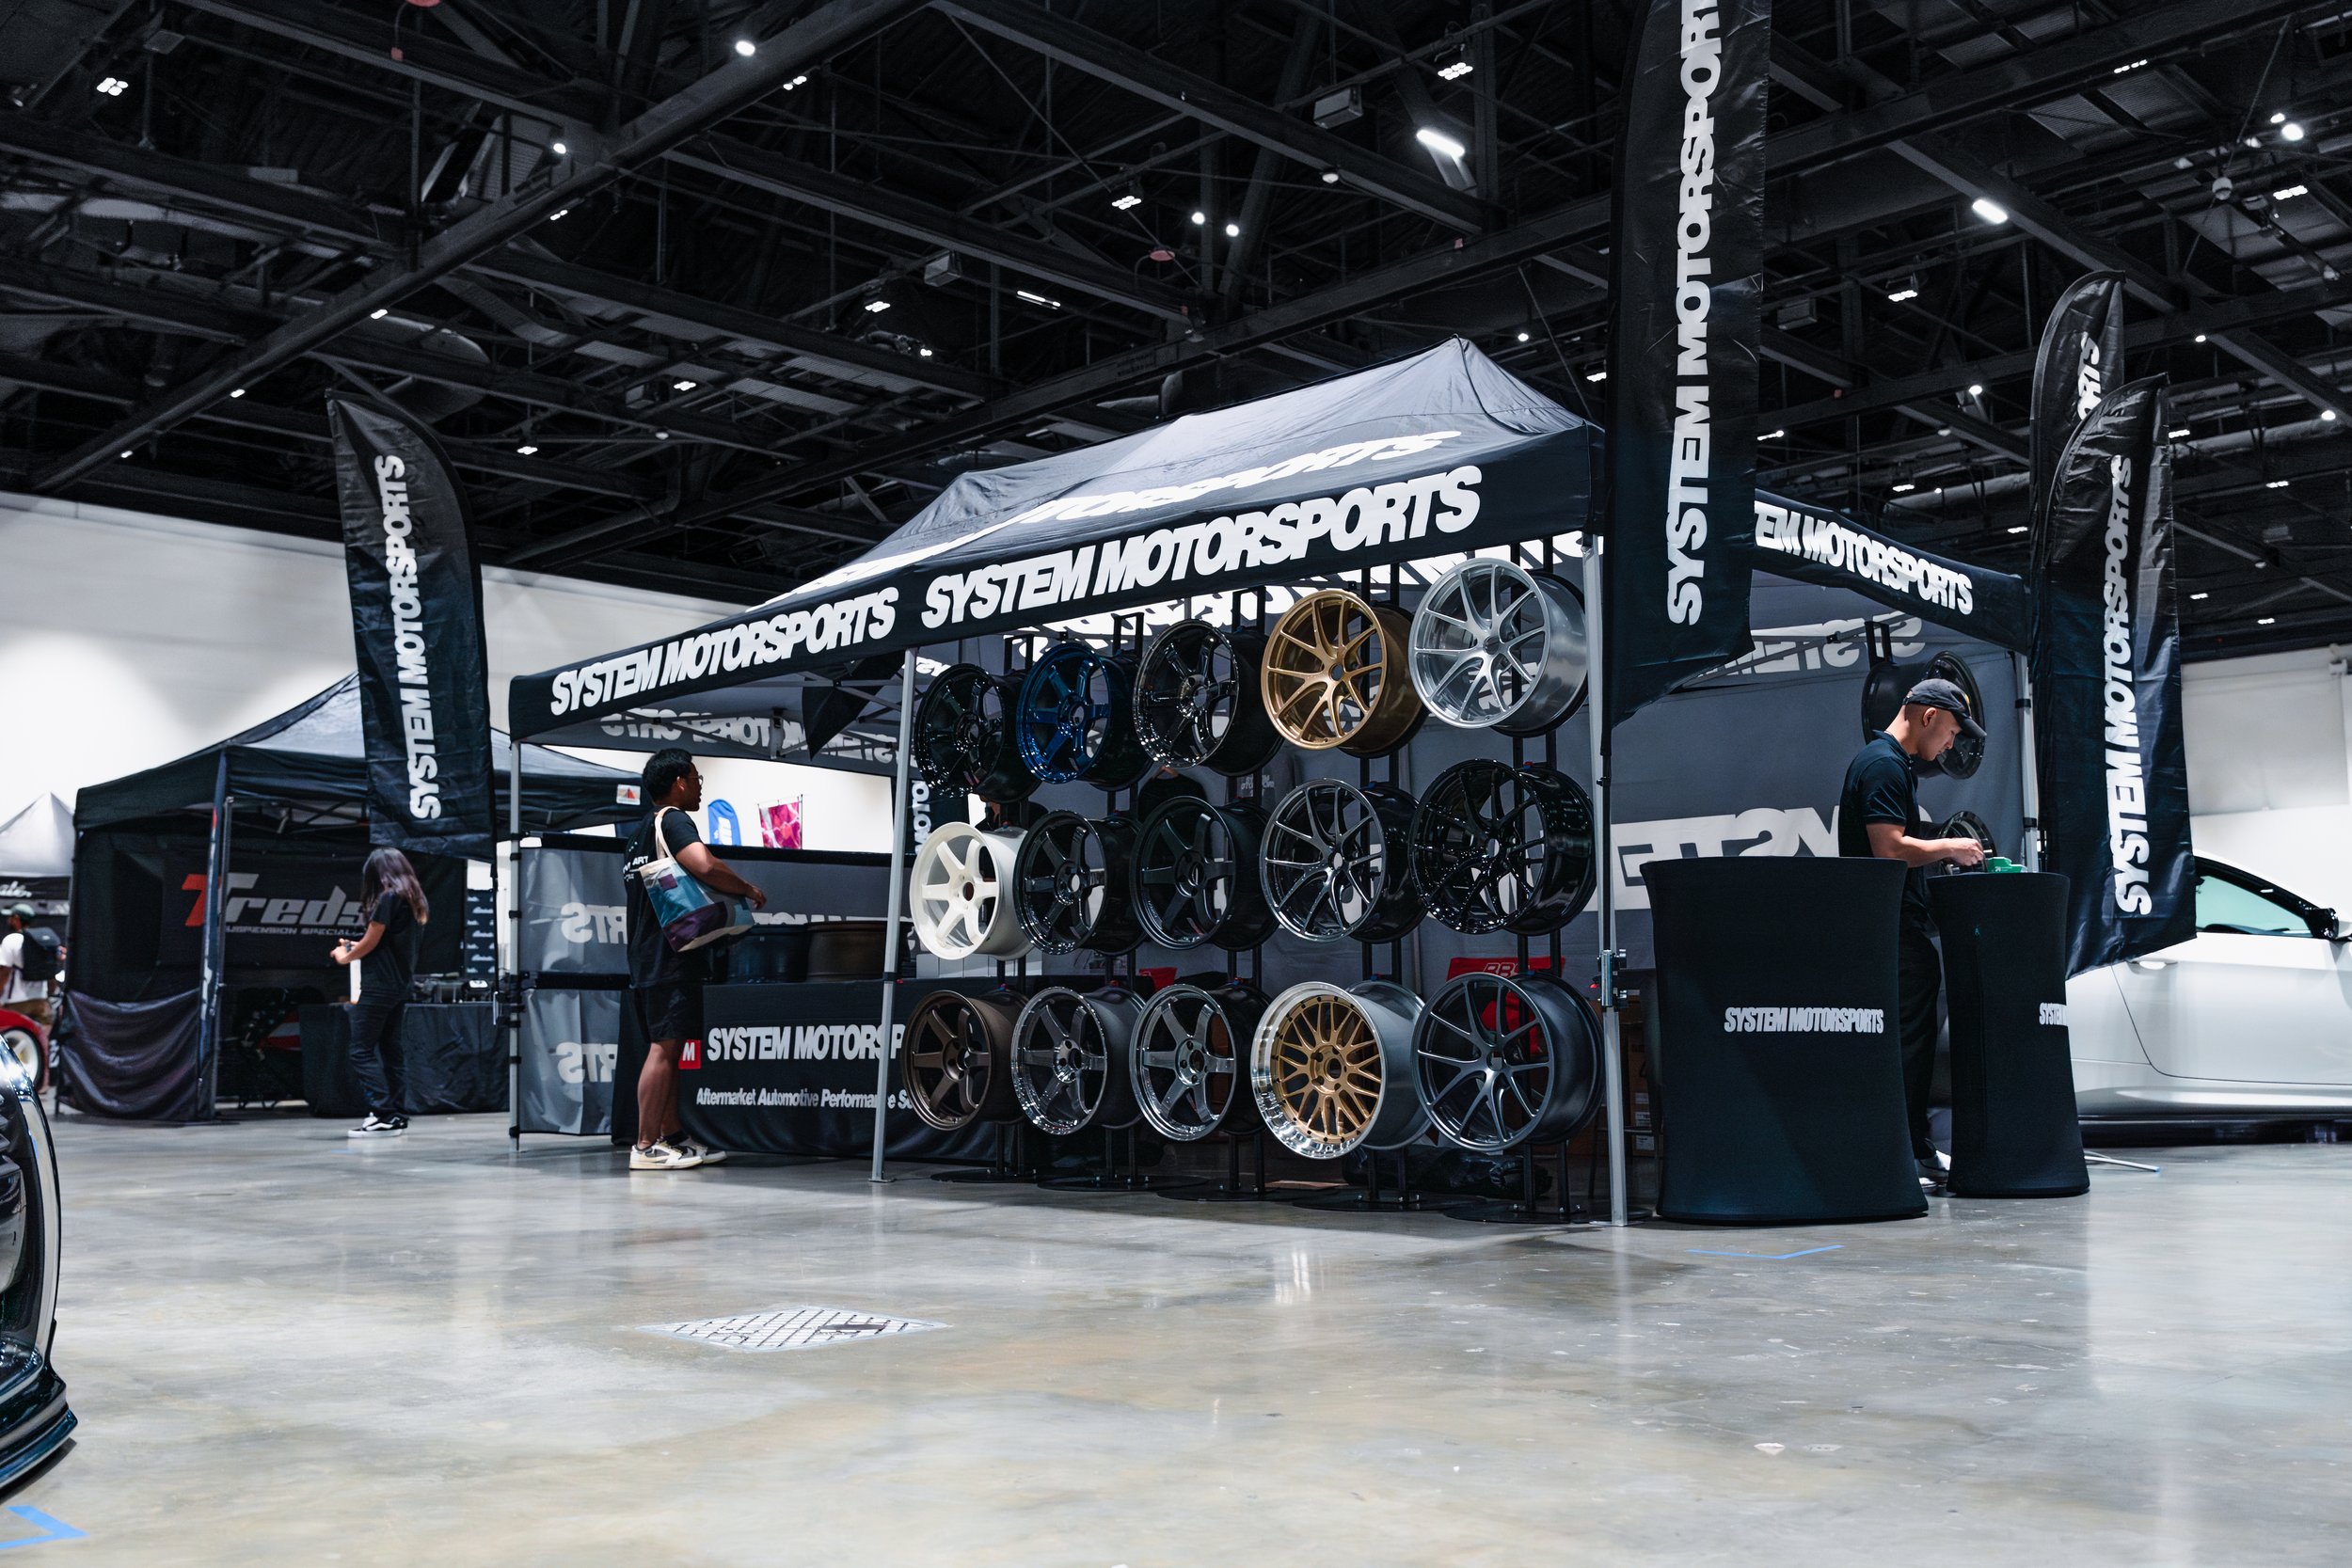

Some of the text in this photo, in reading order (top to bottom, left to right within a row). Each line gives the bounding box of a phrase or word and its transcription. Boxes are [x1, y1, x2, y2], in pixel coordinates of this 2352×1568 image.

[921, 546, 1095, 629] SYSTEM
[1091, 466, 1483, 596] MOTORSPORTS
[1666, 385, 1709, 626] SYSTEM
[1802, 515, 1973, 615] MOTORSPORTS
[373, 454, 441, 821] SYSTEM MOTORSPORTS
[550, 587, 898, 716] SYSTEM MOTORSPORTS
[2104, 454, 2151, 915] SYSTEM MOTORSPORTS
[226, 926, 297, 936] USPENSION
[707, 1026, 792, 1061] SYSTEM
[1724, 1006, 1883, 1034] SYSTEM MOTORSPORTS
[696, 1087, 756, 1106] Aftermarket
[757, 1087, 818, 1106] Automotive
[820, 1088, 897, 1109] Performae
